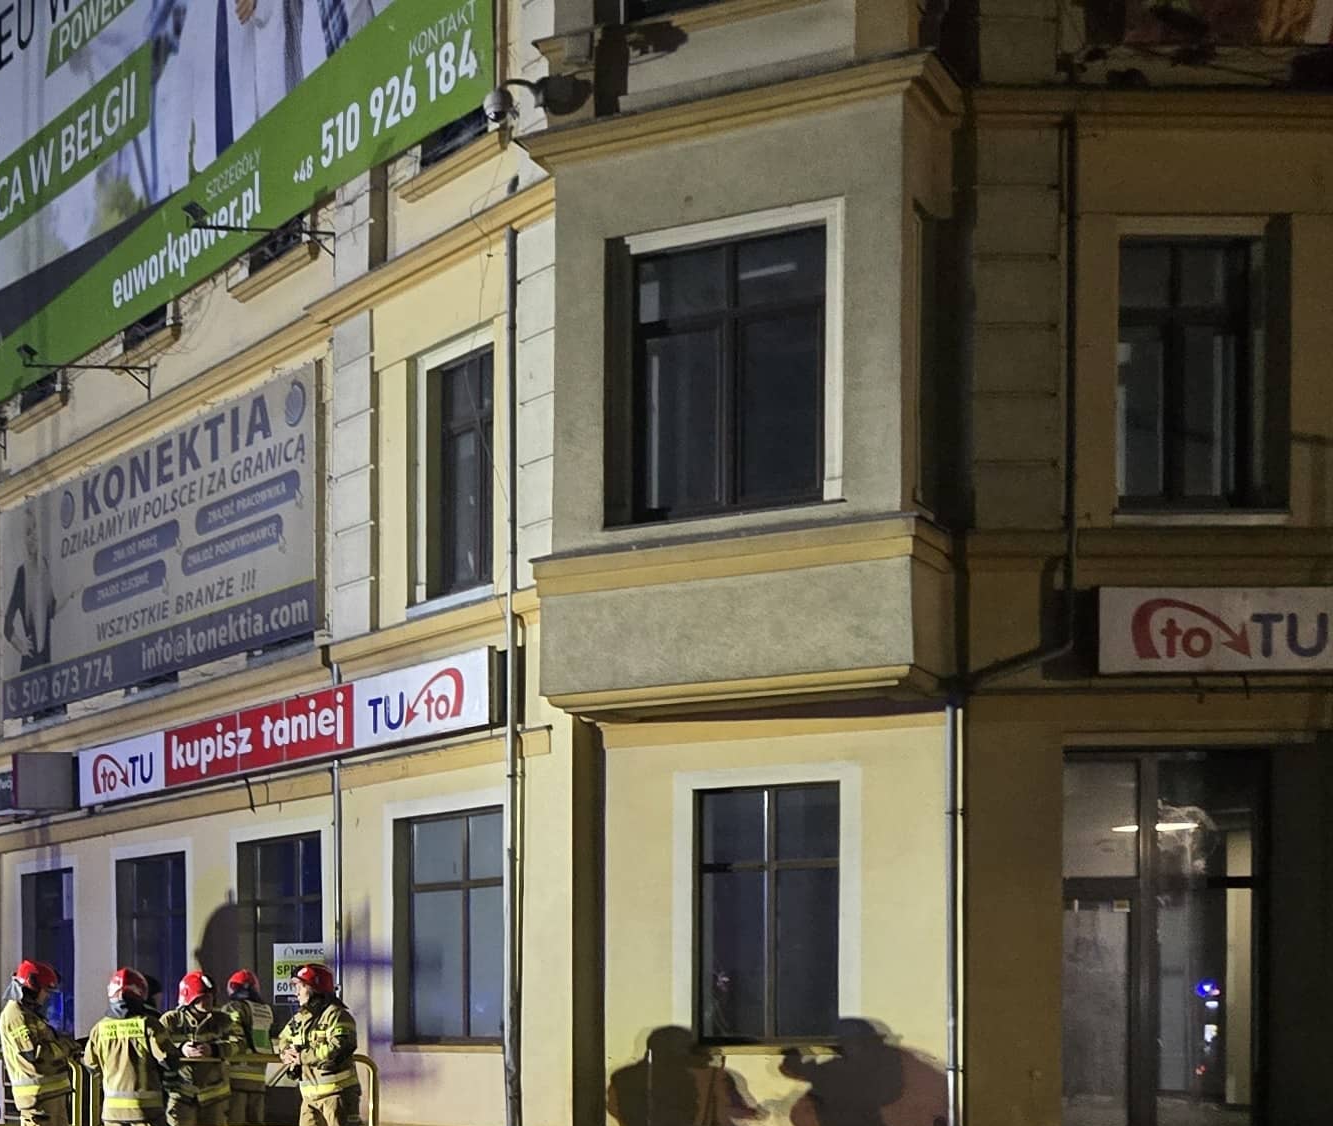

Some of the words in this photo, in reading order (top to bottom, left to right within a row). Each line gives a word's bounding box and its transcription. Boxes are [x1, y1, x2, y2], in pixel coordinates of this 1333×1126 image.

[409, 0, 476, 60] KONTAKT
[29, 138, 54, 195] W
[61, 71, 136, 174] BELGII
[293, 155, 314, 184] +48
[321, 102, 360, 168] 510
[370, 65, 417, 136] 926
[426, 29, 478, 103] 184
[112, 171, 261, 308] euworkpower.pl
[61, 512, 126, 559] DZIAŁAMY
[127, 507, 141, 530] W
[143, 483, 196, 526] POLSCE
[208, 473, 226, 498] ZA
[232, 433, 306, 485] GRANICĄ
[83, 394, 272, 521] KONEKTIA
[22, 680, 49, 708] 502
[52, 668, 80, 696] 673
[84, 655, 113, 687] 774
[141, 598, 309, 671] info@konektia.com
[96, 600, 169, 642] WSZYSTKIE
[175, 577, 234, 615] BRANŻE
[1160, 618, 1213, 658] to
[1250, 612, 1329, 658] TU
[100, 767, 116, 791] to
[129, 751, 153, 787] TU
[171, 723, 253, 774] kupisz
[261, 692, 344, 749] taniej
[367, 691, 404, 735] TU
[424, 689, 450, 722] to
